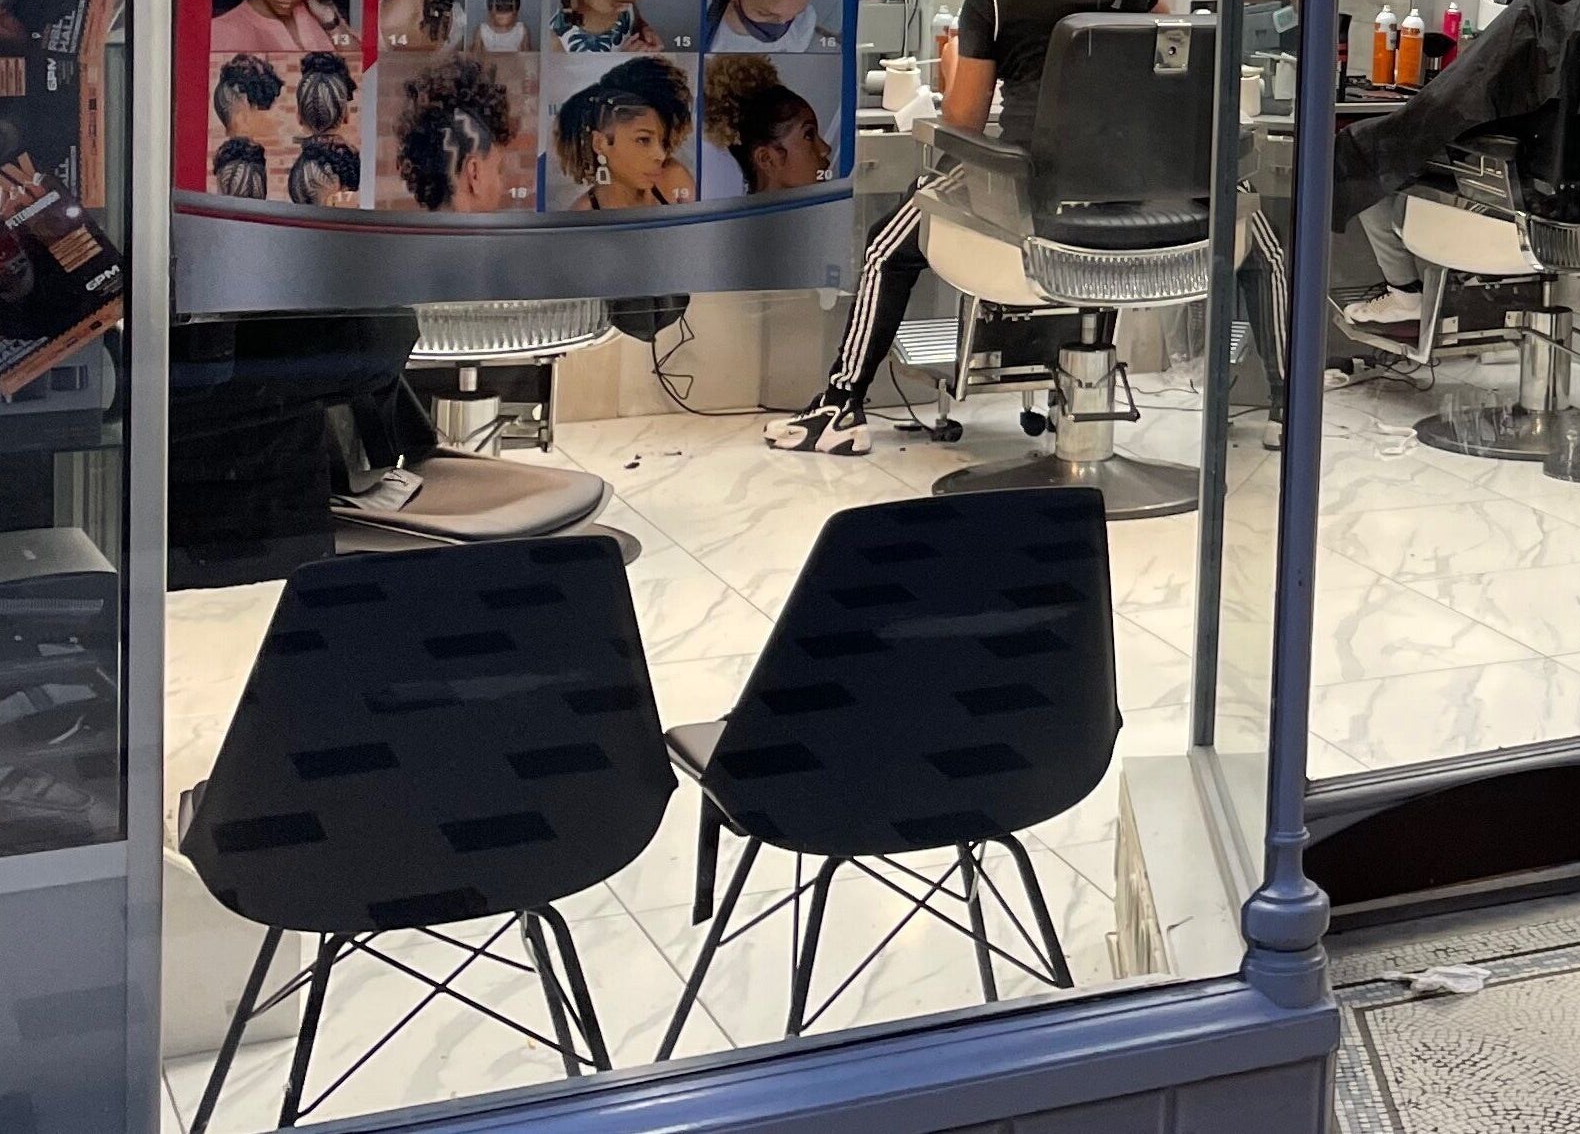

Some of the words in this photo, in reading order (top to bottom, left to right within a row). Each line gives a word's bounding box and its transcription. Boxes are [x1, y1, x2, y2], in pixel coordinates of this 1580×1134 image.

[332, 33, 350, 45] 13
[388, 34, 407, 46] 14
[673, 35, 691, 47] 15
[819, 36, 836, 48] 16
[816, 169, 832, 180] 20
[335, 191, 352, 202] 17
[672, 188, 689, 199] 19
